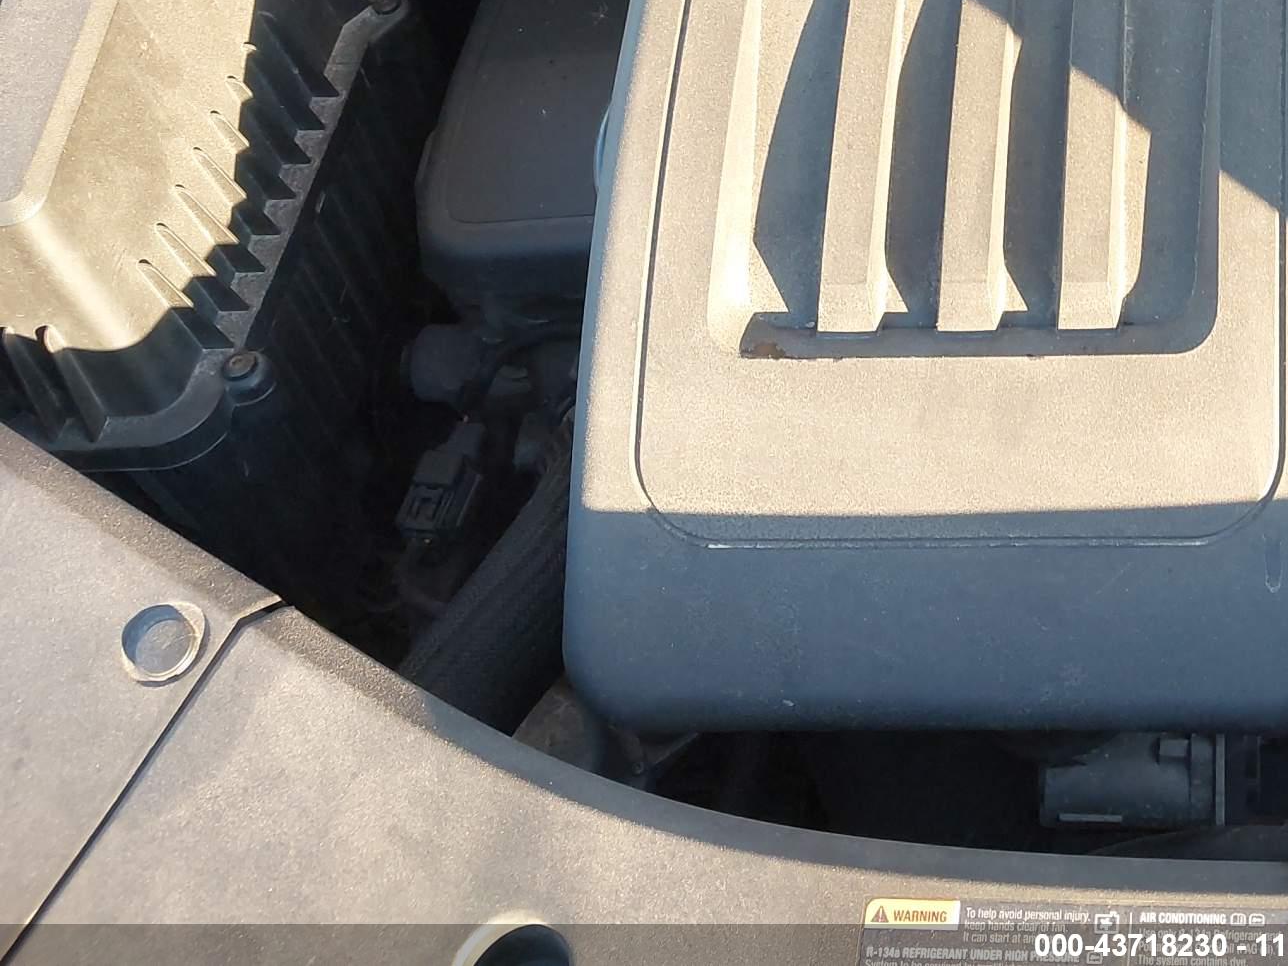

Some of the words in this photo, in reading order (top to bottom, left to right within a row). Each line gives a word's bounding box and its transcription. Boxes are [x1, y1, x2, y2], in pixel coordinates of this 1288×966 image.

[893, 909, 948, 924] WARNING
[966, 907, 977, 919] To
[978, 907, 997, 921] help
[999, 909, 1023, 920] avoid
[1024, 909, 1063, 923] personal
[1140, 912, 1156, 923] AIR
[1158, 913, 1226, 925] CONDITIONING
[964, 919, 986, 933] keep
[988, 920, 1015, 932] hands
[1017, 921, 1038, 933] clear
[971, 933, 987, 943] can
[990, 933, 1010, 943] start
[1012, 933, 1021, 944] at
[866, 946, 901, 959] R-134a
[901, 946, 968, 960] REFRIGERANT
[969, 947, 1002, 961] UNDER
[1005, 950, 1029, 962] HIGH
